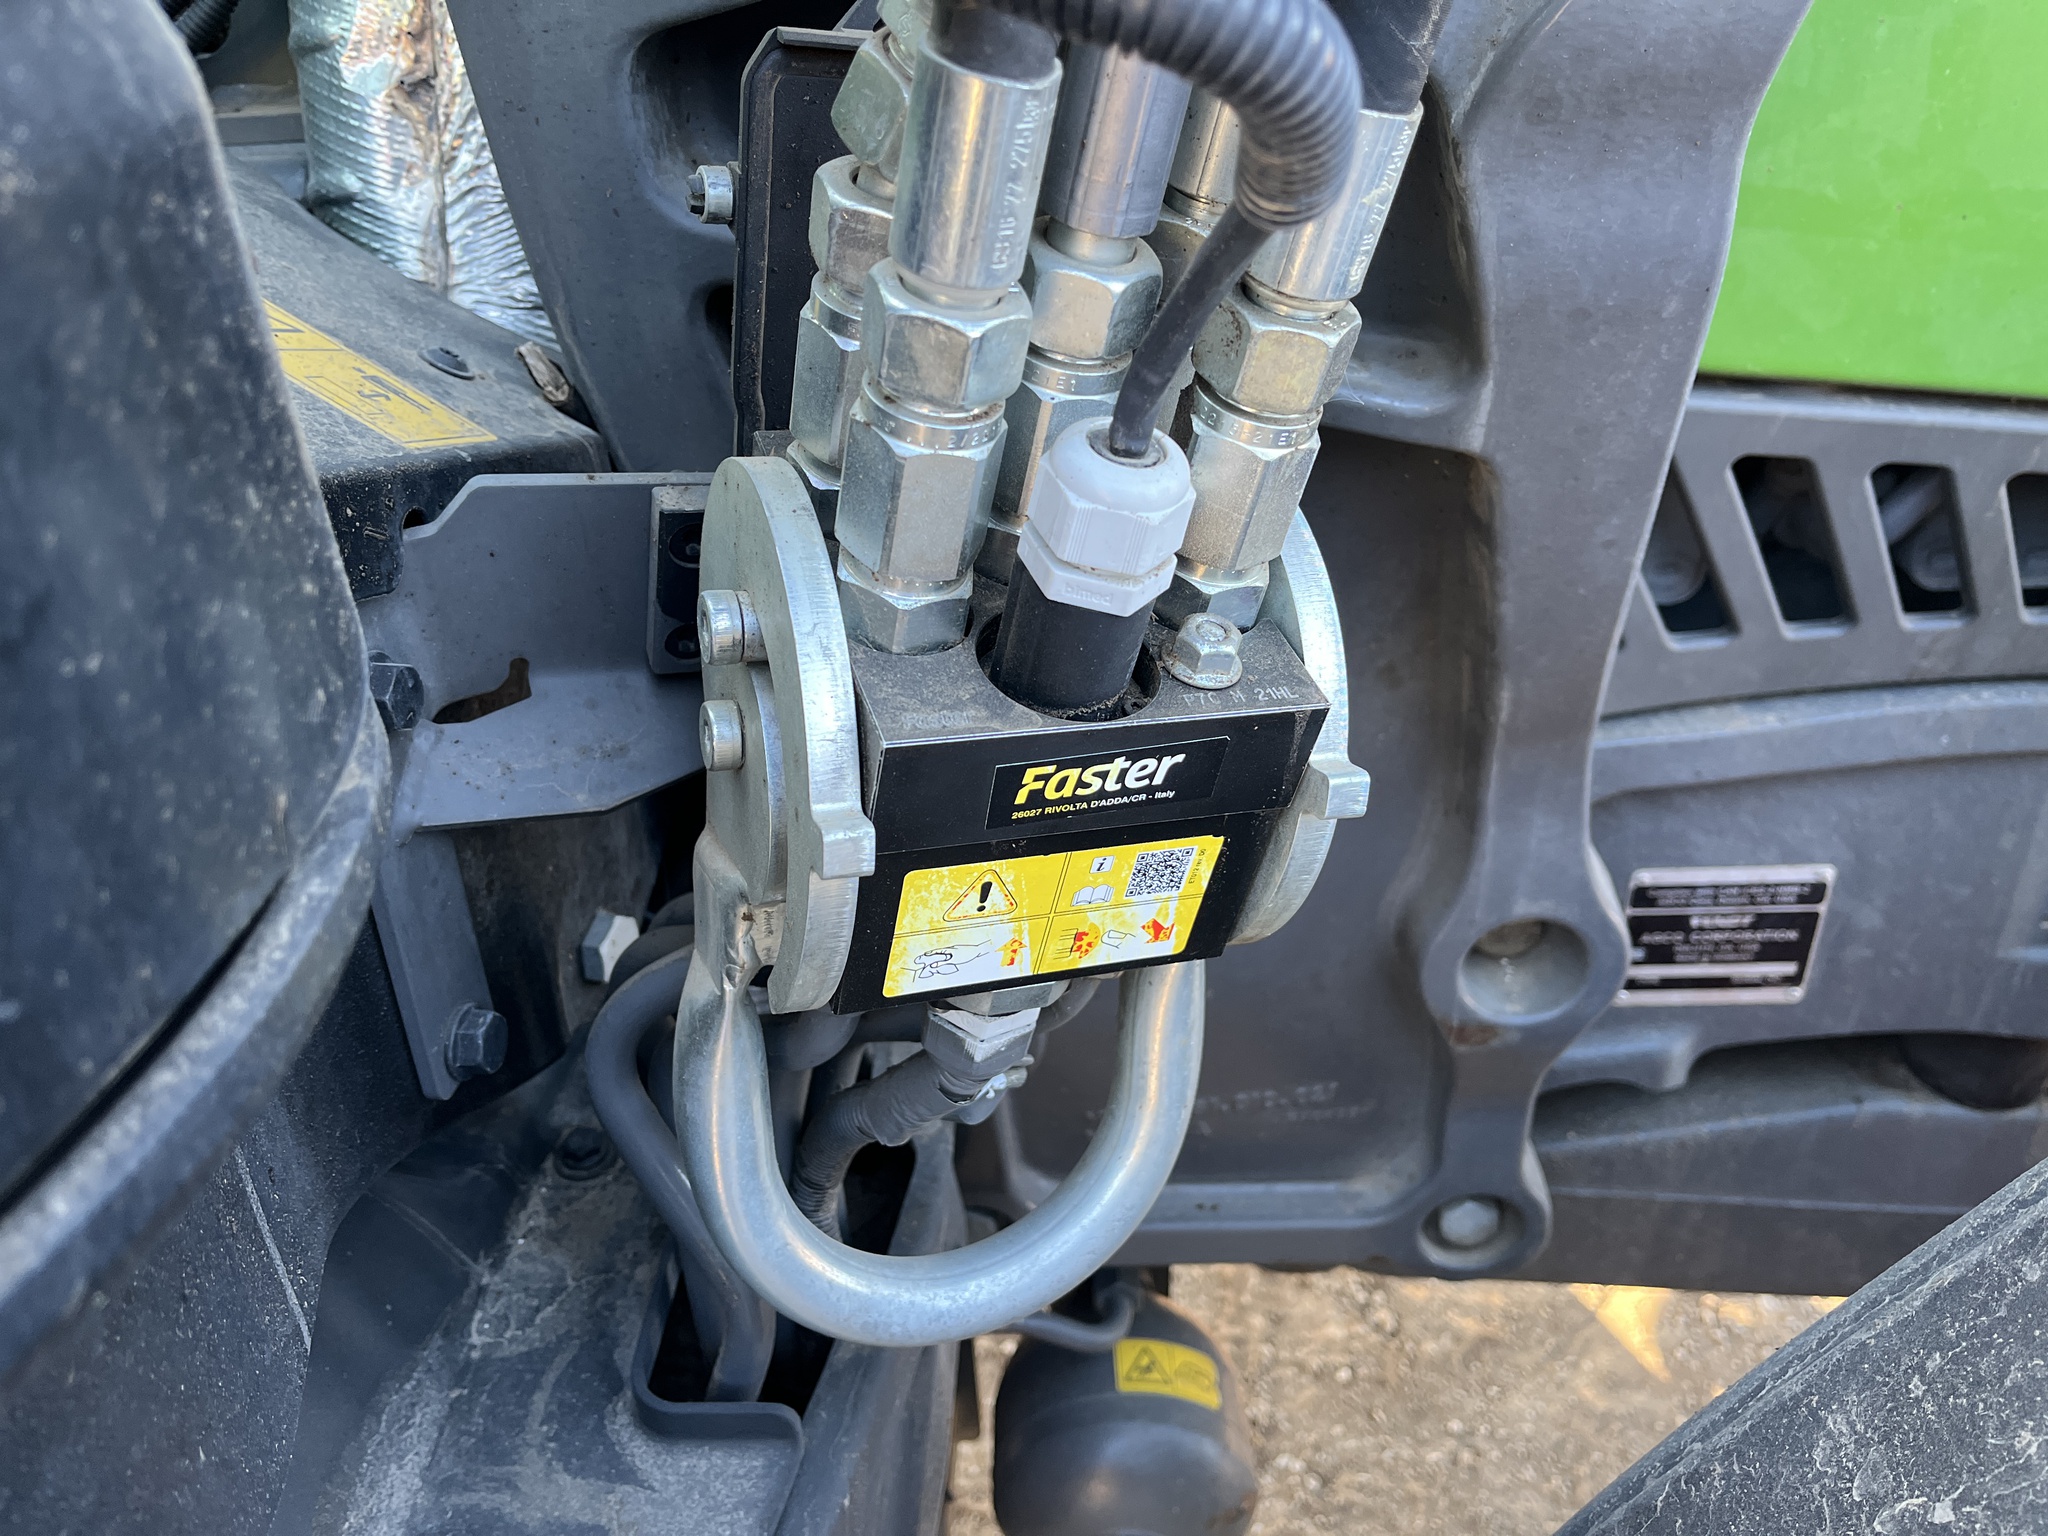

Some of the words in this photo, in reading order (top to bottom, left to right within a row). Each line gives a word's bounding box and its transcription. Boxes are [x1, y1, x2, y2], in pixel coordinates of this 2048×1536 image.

[1254, 686, 1300, 702] 21HL
[1013, 753, 1187, 806] Faster
[1010, 808, 1043, 820] 26027
[1044, 801, 1089, 815] RIVOLTA
[1090, 793, 1147, 808] D'ADDA/CR
[1154, 789, 1176, 800] Italy
